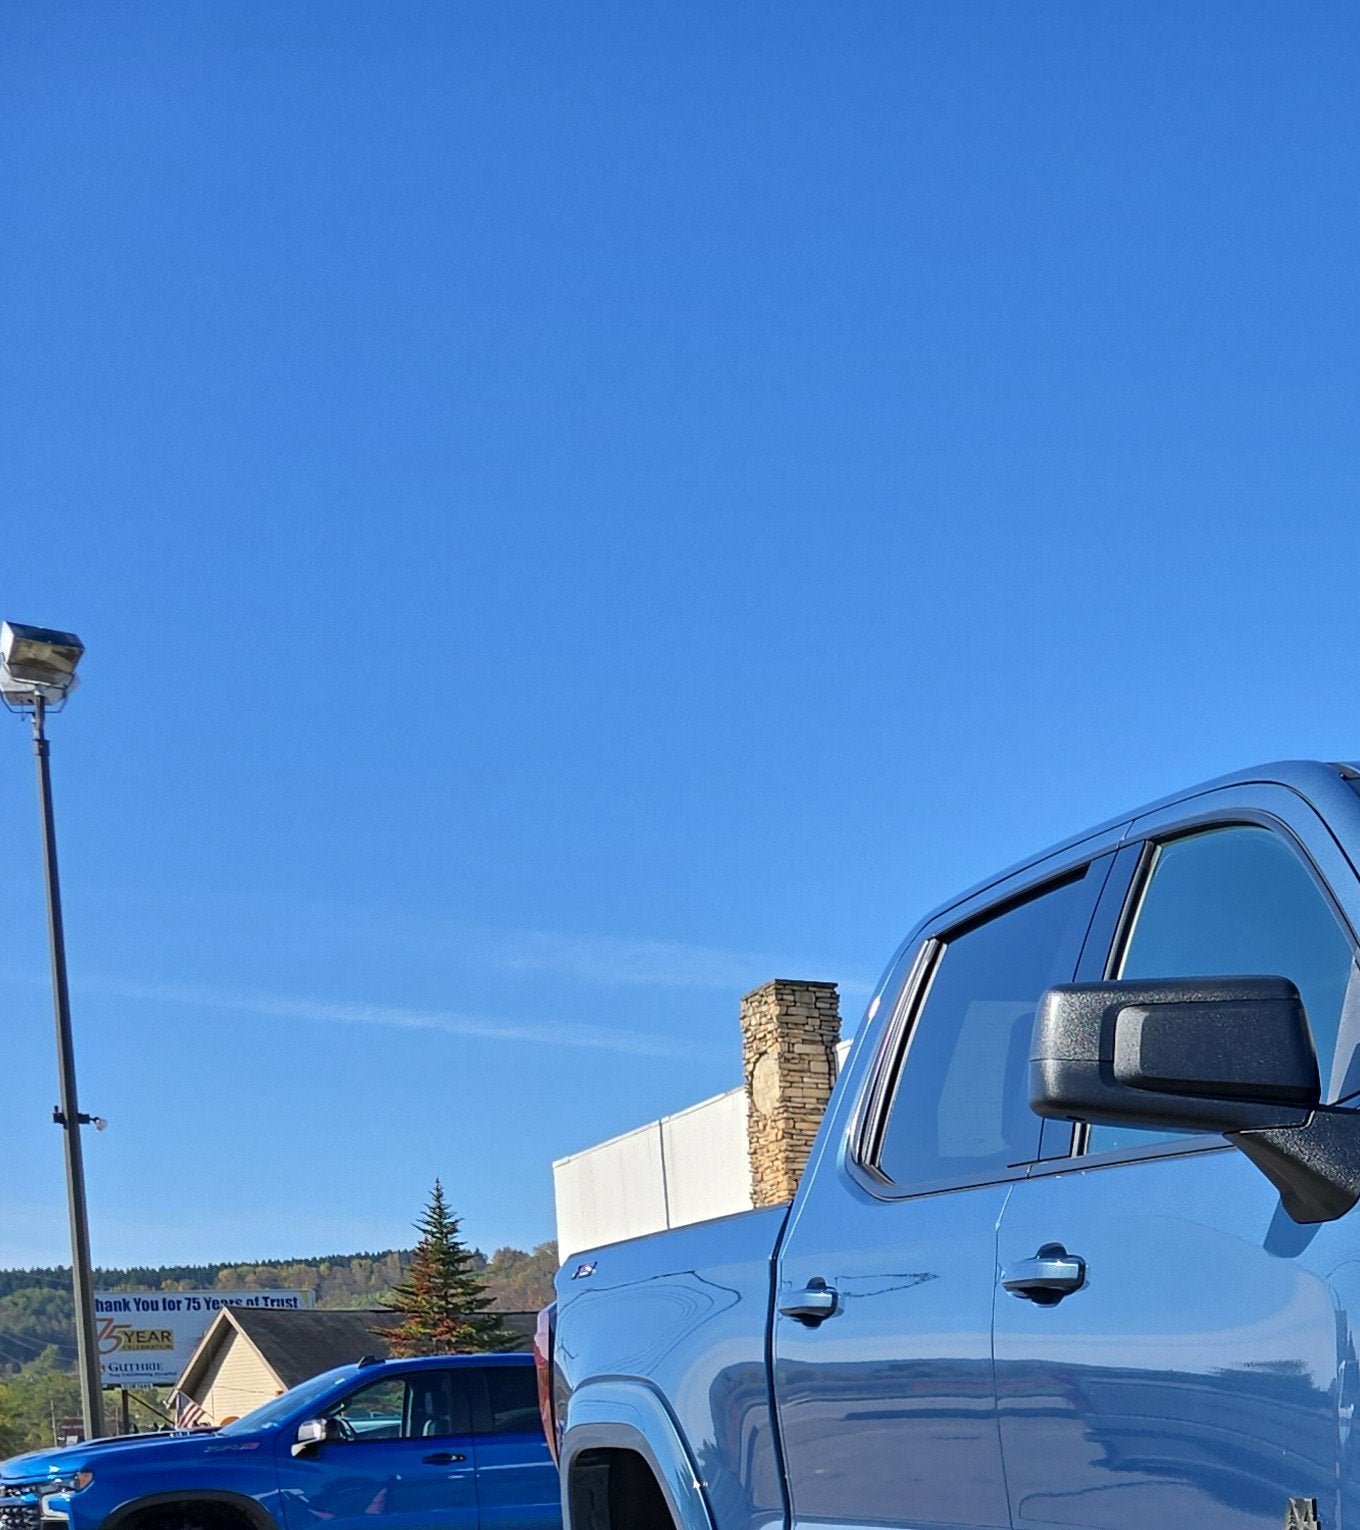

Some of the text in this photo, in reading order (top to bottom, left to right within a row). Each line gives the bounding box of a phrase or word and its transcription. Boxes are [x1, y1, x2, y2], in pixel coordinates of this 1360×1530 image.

[94, 1297, 131, 1312] hank
[133, 1297, 159, 1312] You
[162, 1297, 182, 1312] for
[185, 1297, 201, 1311] 75
[262, 1296, 298, 1308] Trust
[95, 1317, 133, 1355] 75
[123, 1330, 172, 1343] YEAR
